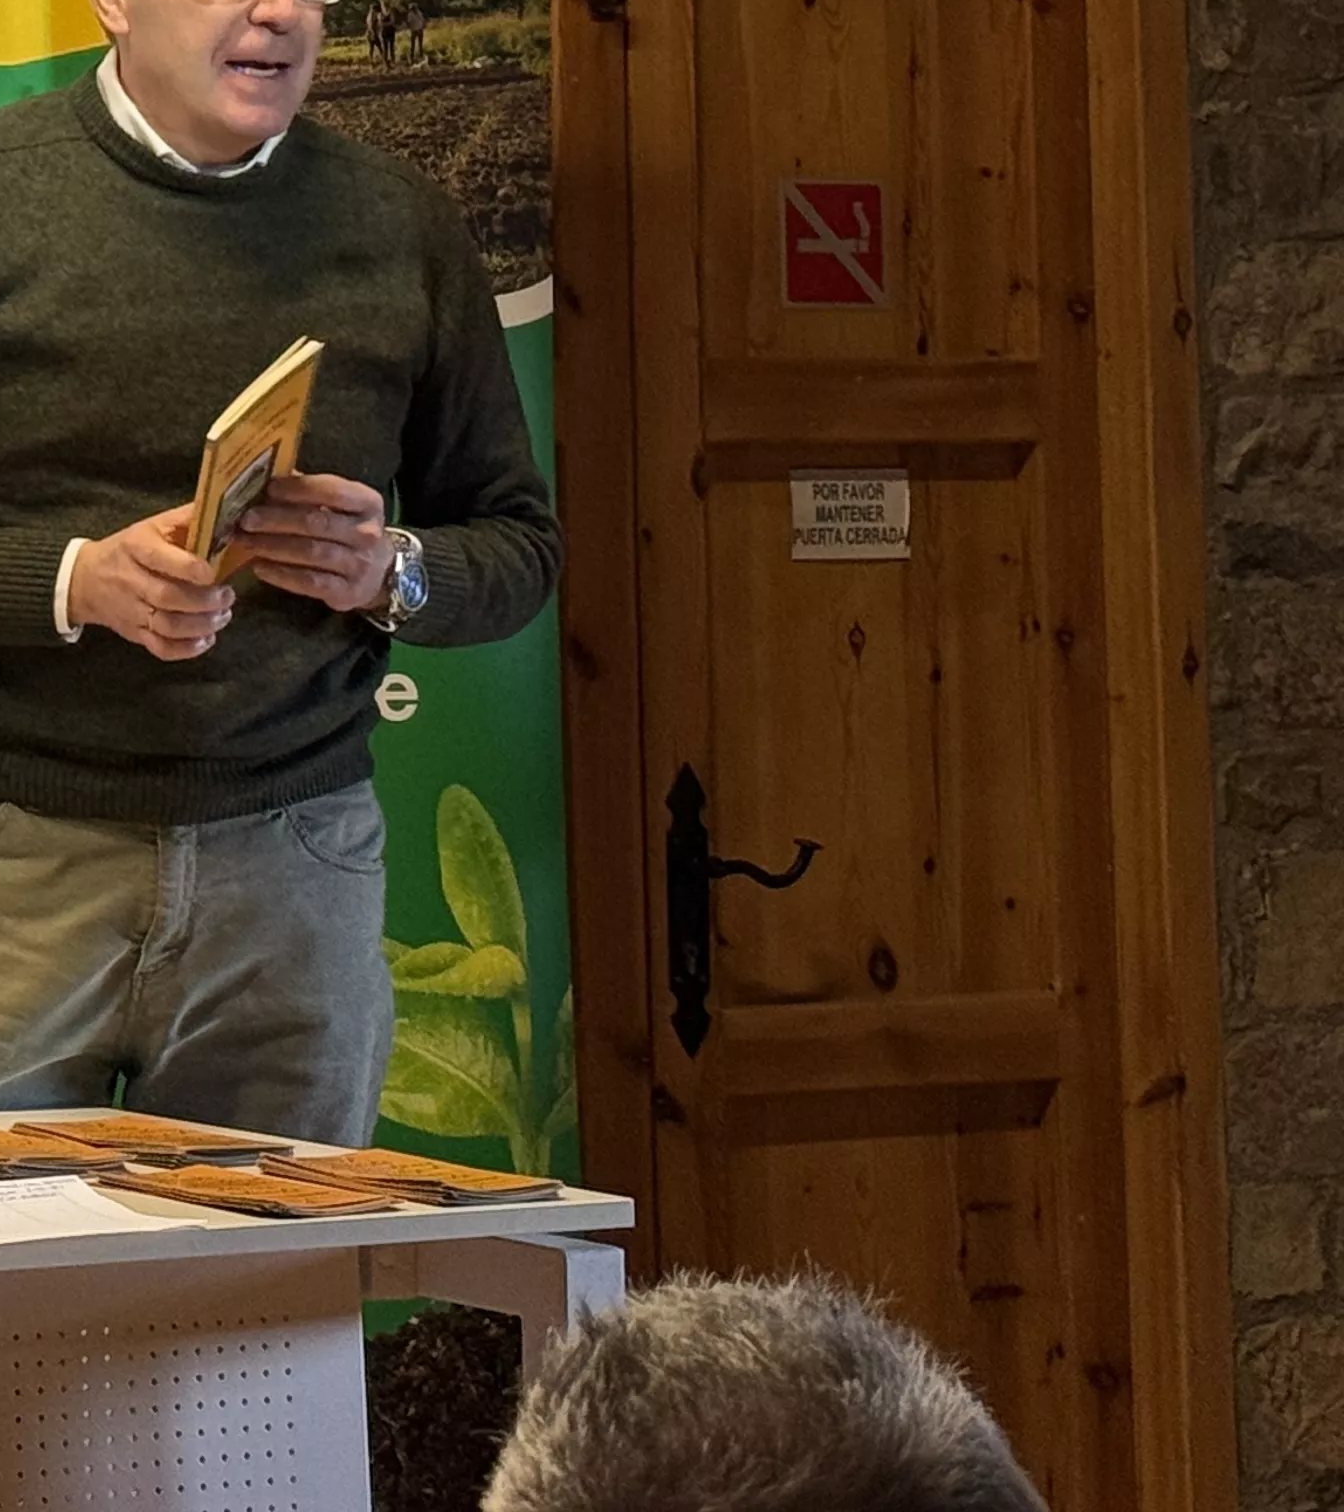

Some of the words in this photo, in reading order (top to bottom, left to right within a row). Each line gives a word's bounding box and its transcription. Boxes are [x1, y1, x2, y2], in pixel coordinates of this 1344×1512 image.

[812, 482, 840, 501] POR
[842, 482, 885, 501] FAVOR
[815, 504, 885, 523] MANTENER
[793, 526, 844, 545] PUERTA
[846, 526, 907, 545] CERRADA
